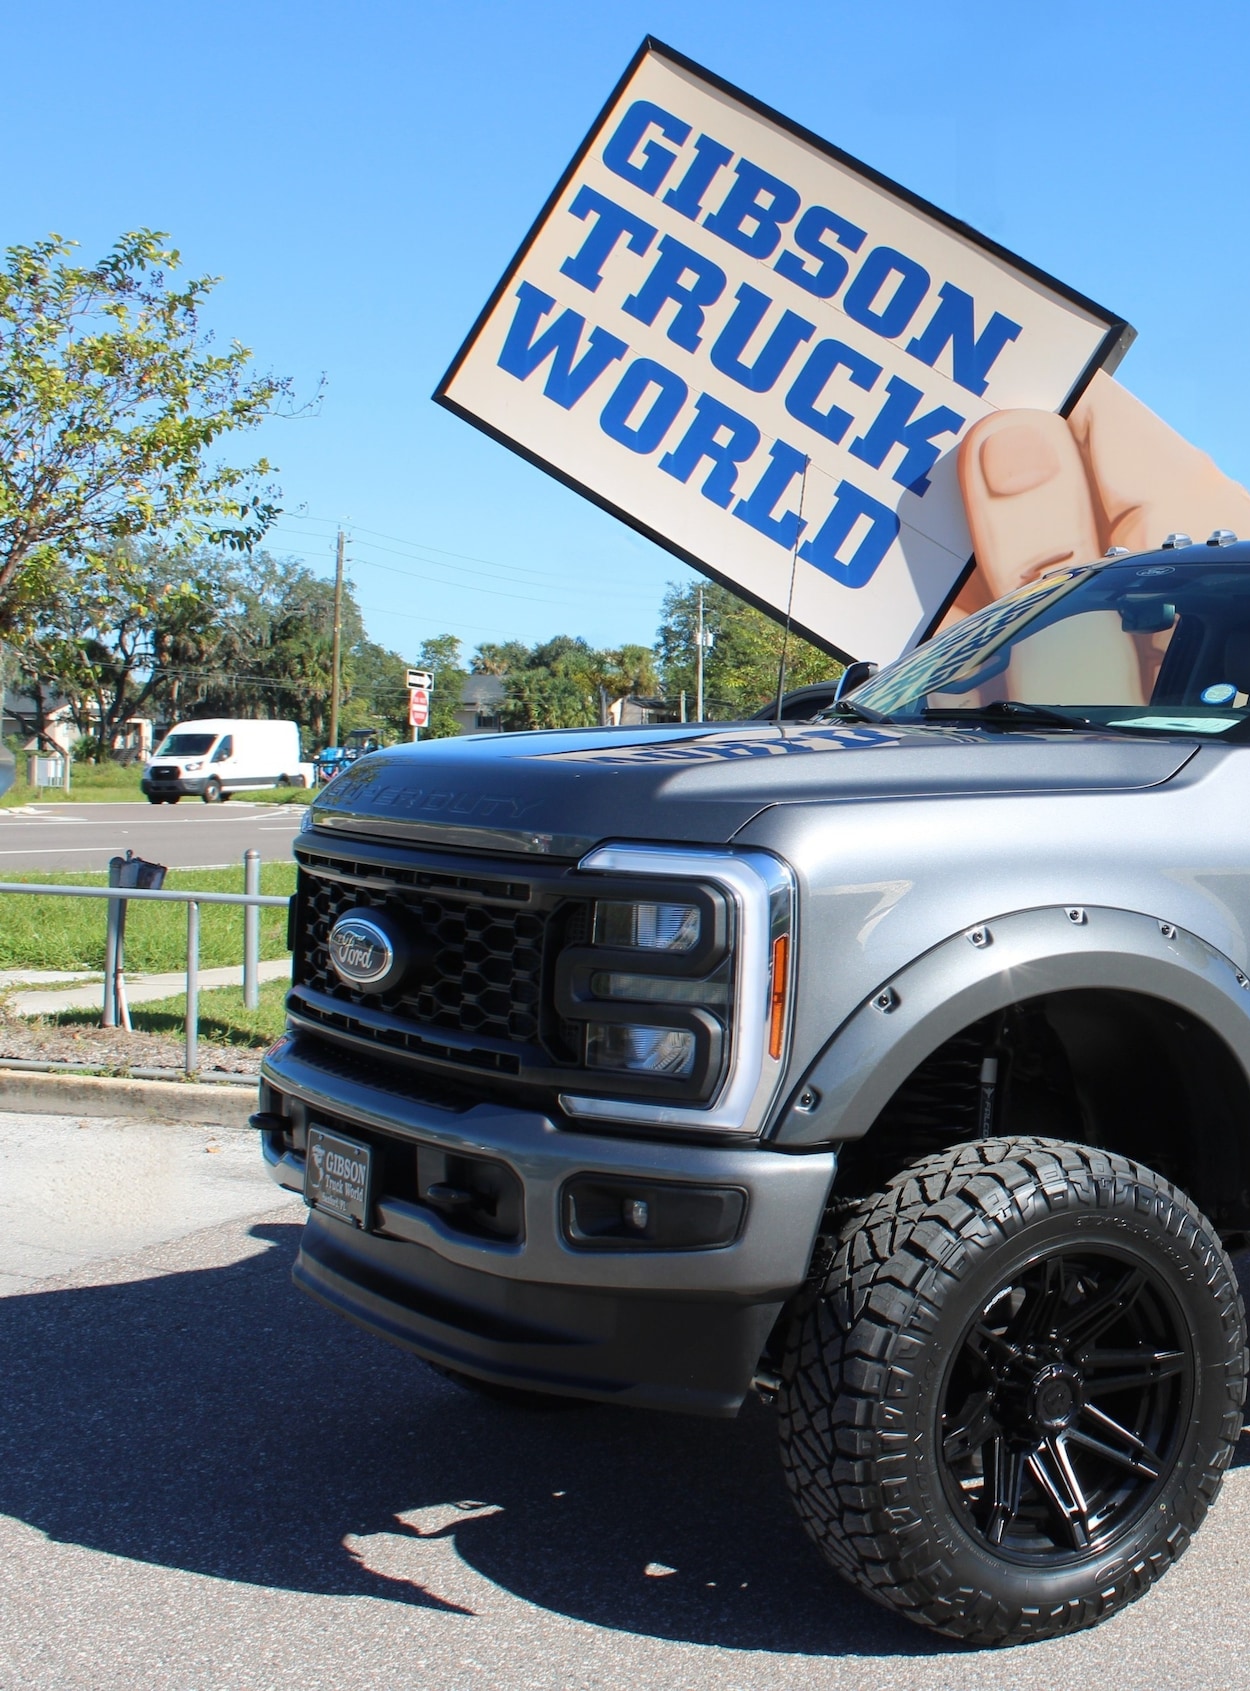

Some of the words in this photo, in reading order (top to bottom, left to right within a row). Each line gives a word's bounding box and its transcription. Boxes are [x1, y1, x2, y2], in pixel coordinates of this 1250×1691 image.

[603, 101, 1022, 396] GIBSON
[560, 185, 965, 495] TRUCK
[498, 281, 900, 589] WORLD
[323, 782, 422, 809] SUPER
[421, 791, 544, 818] DUTY
[335, 930, 373, 968] Ford
[326, 1152, 366, 1185] GIBSON
[325, 1175, 343, 1193] Truck
[345, 1183, 363, 1202] World
